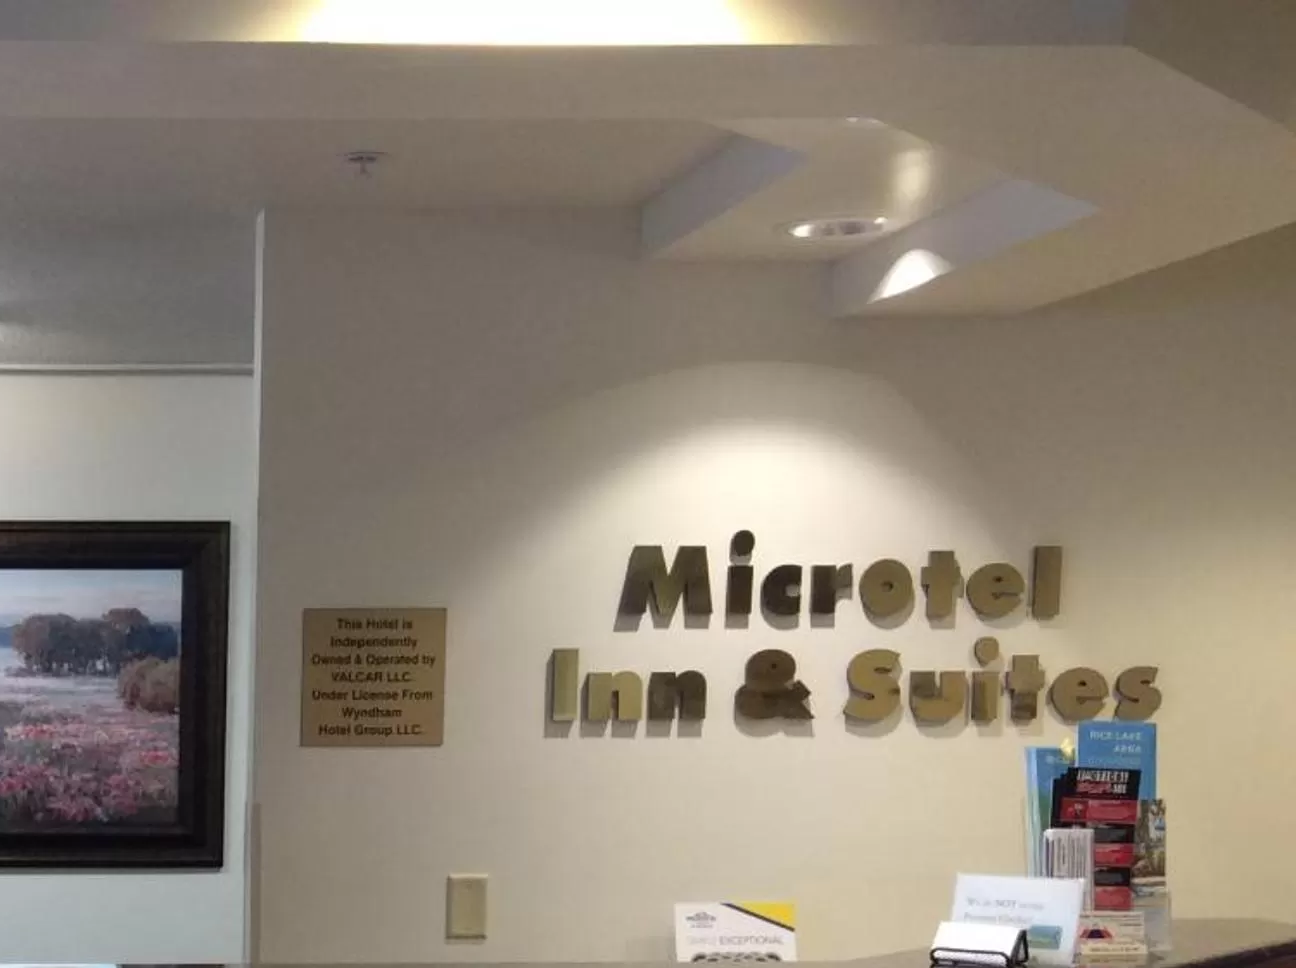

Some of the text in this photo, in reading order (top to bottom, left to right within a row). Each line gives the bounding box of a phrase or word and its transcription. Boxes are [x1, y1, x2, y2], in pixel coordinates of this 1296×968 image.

[617, 529, 1063, 622] Microtel
[337, 618, 362, 629] This
[366, 618, 398, 629] Hotel
[330, 636, 417, 648] Independently
[312, 654, 351, 665] Owned
[366, 654, 419, 666] Operated
[422, 654, 435, 667] by
[332, 672, 382, 683] VALCAR
[546, 636, 1163, 726] Inn & Suites
[312, 689, 433, 701] Under License From
[342, 707, 402, 720] Wyndham
[318, 724, 350, 736] Hotel
[354, 724, 393, 738] Group
